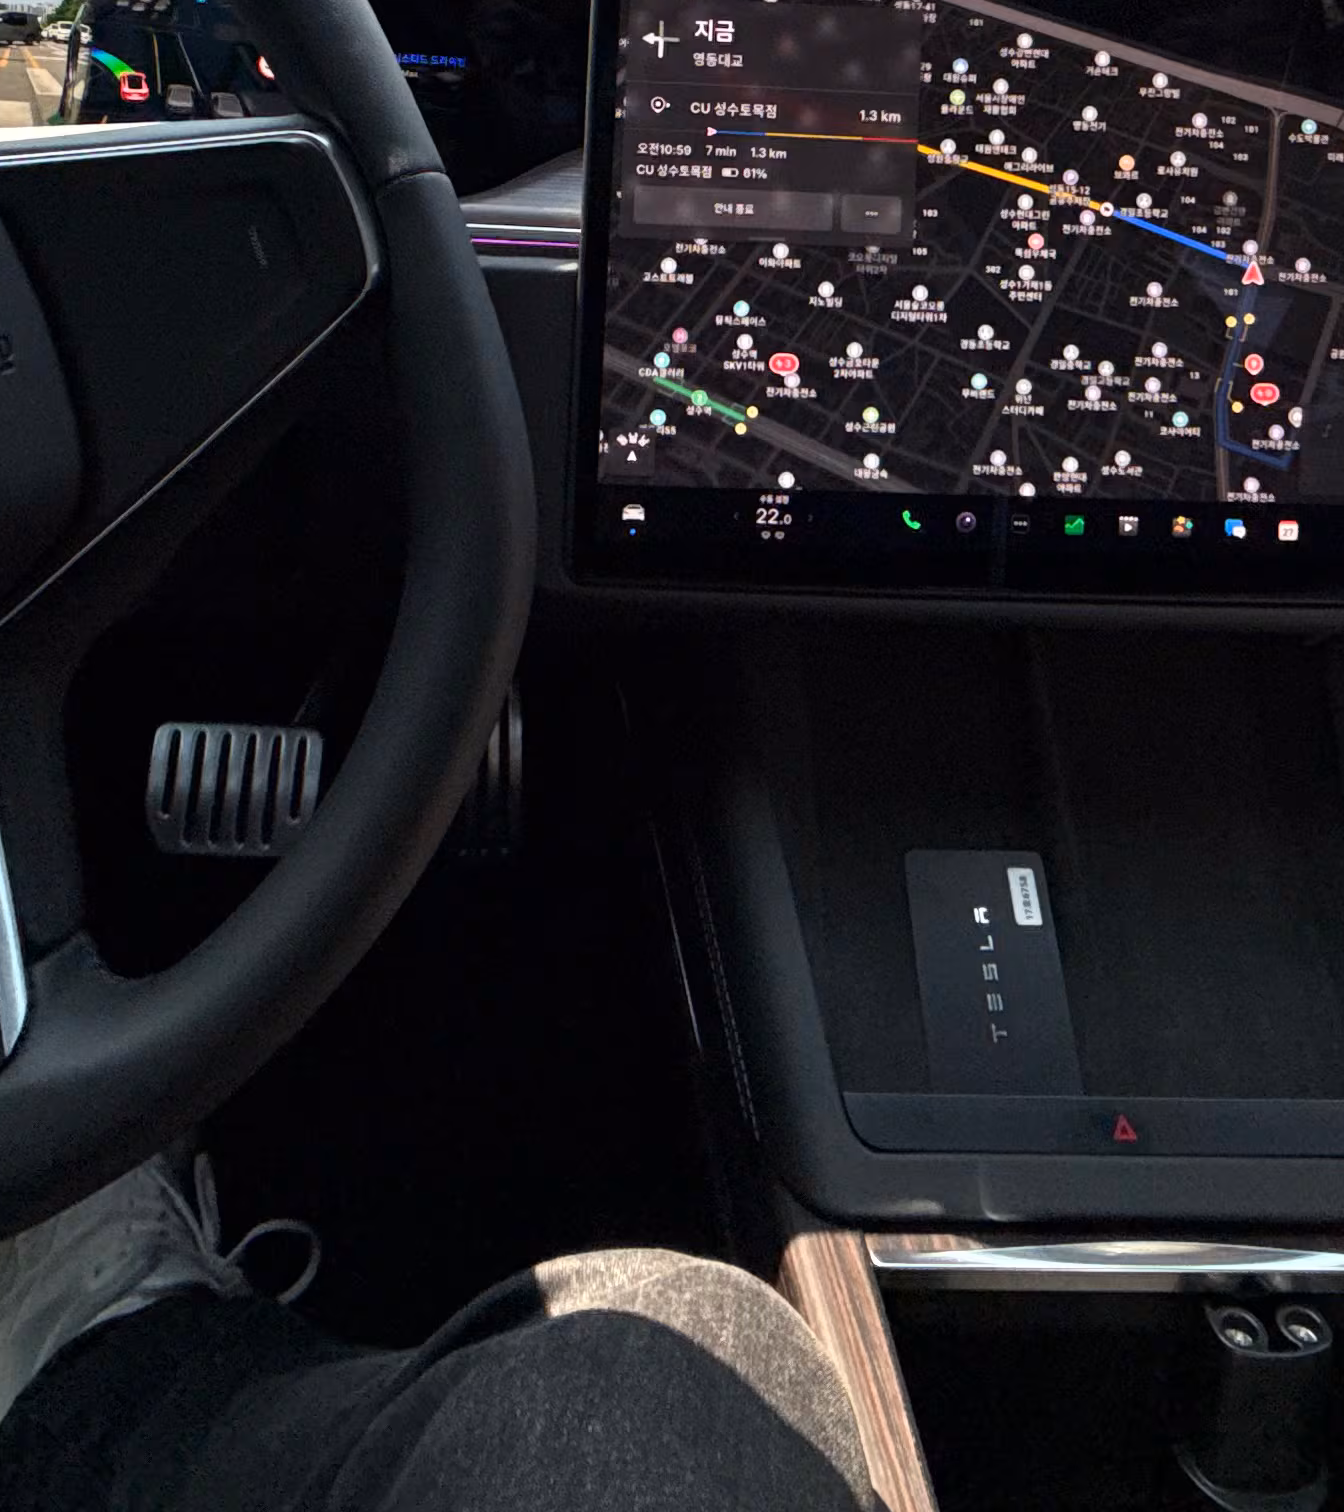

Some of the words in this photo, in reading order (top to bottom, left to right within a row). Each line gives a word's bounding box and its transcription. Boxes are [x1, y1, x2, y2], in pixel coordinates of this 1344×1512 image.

[694, 19, 735, 43] 지금
[692, 52, 744, 68] 영동대교
[690, 101, 711, 114] CU
[714, 101, 778, 119] 성수토목점
[859, 109, 878, 122] 1.3
[880, 110, 902, 123] km
[1175, 127, 1225, 139] 전기차충전소
[636, 142, 692, 157] 오전10:59
[705, 145, 713, 156] 7
[715, 145, 737, 157] min
[751, 147, 767, 159] 1.3
[768, 147, 788, 159] km
[636, 163, 655, 176] CU
[657, 164, 713, 179] 성수토목점
[743, 167, 768, 179] 61%
[713, 203, 733, 215] 안내
[1062, 224, 1112, 236] 전기차충전소
[675, 242, 727, 255] 전기차충전소
[1278, 271, 1328, 284] 전기차충전소
[1129, 296, 1180, 308] 전기차충전소
[731, 349, 758, 360] 성수역
[1134, 356, 1185, 368] 전기차충전소
[766, 386, 817, 399] 전기차충전소
[1127, 391, 1178, 403] 전기차충전소
[685, 405, 712, 416] 성수역
[1067, 399, 1118, 411] 전기차충전소
[972, 464, 1023, 477] 전기차충전소
[756, 508, 793, 526] 22.0
[973, 906, 1008, 1043] TESLA
